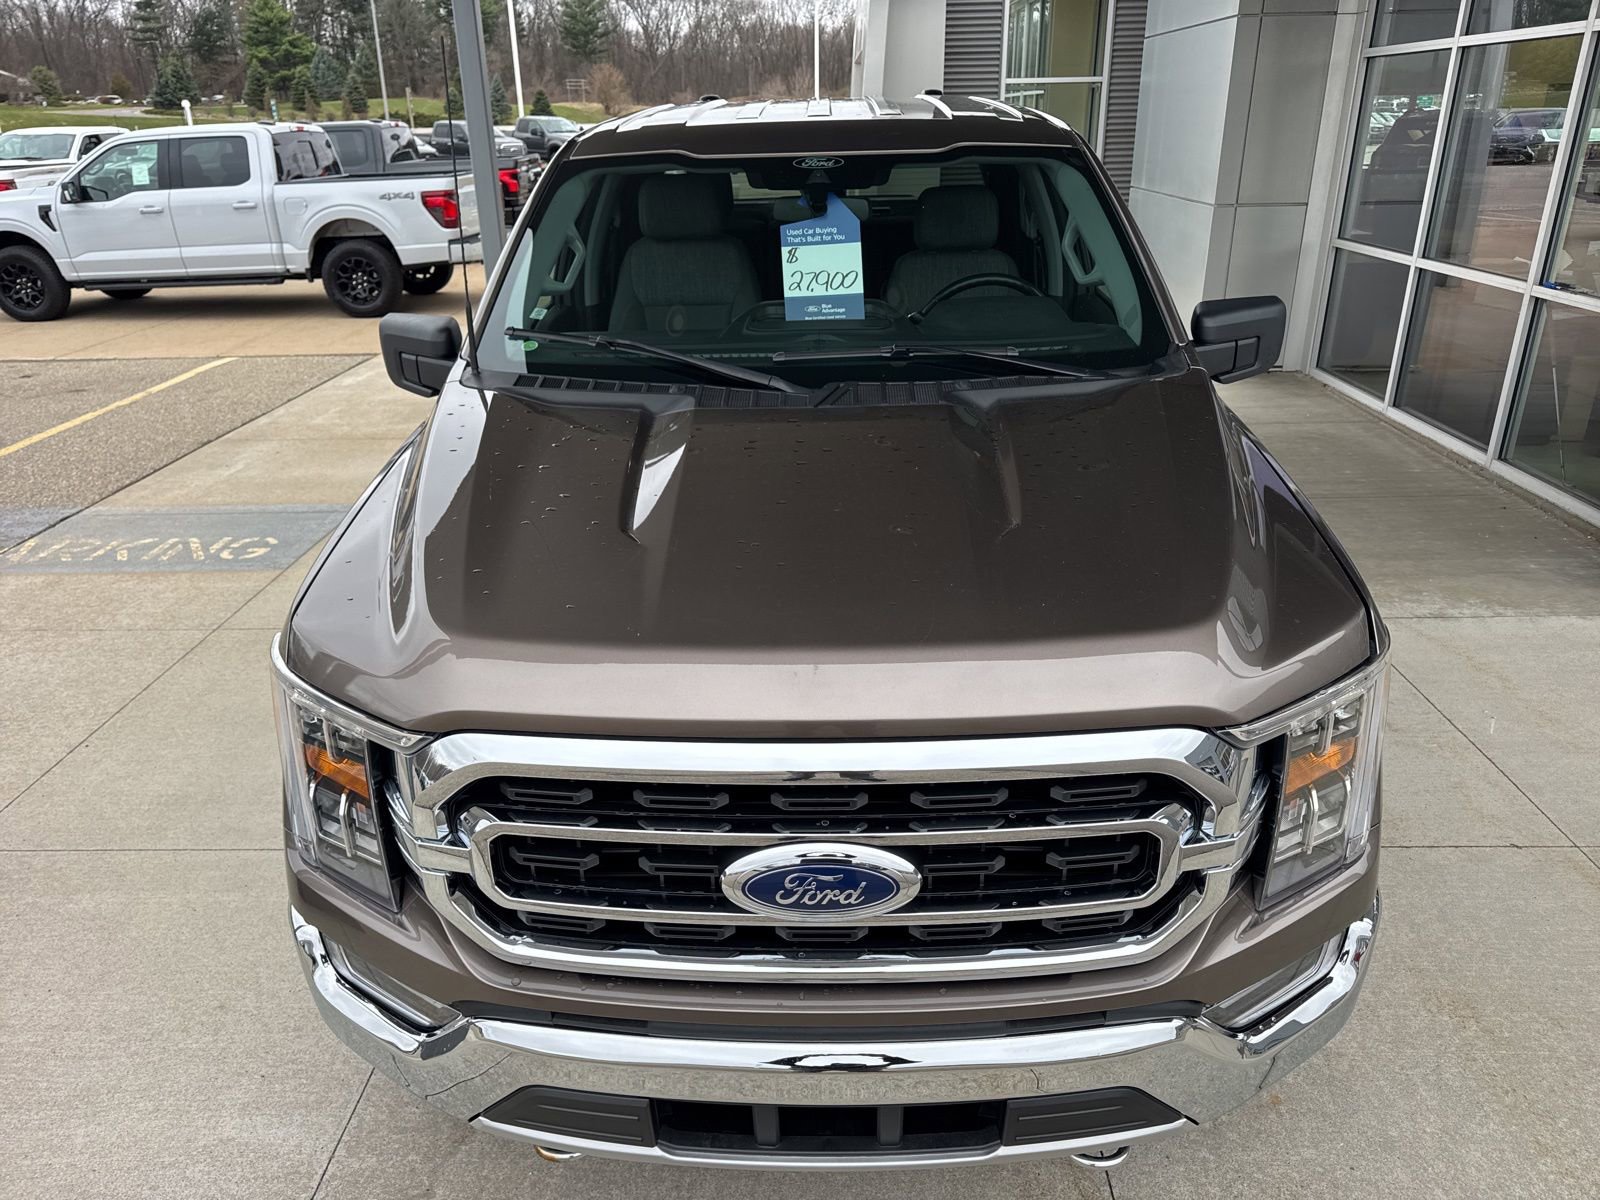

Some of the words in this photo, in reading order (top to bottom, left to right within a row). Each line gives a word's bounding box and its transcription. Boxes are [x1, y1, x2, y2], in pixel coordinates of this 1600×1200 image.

[802, 158, 835, 167] Ford
[786, 228, 803, 236] Used
[815, 226, 838, 235] Buying
[787, 235, 806, 243] That's
[833, 233, 846, 241] You
[0, 536, 279, 564] ARKING
[775, 872, 867, 905] Ford
